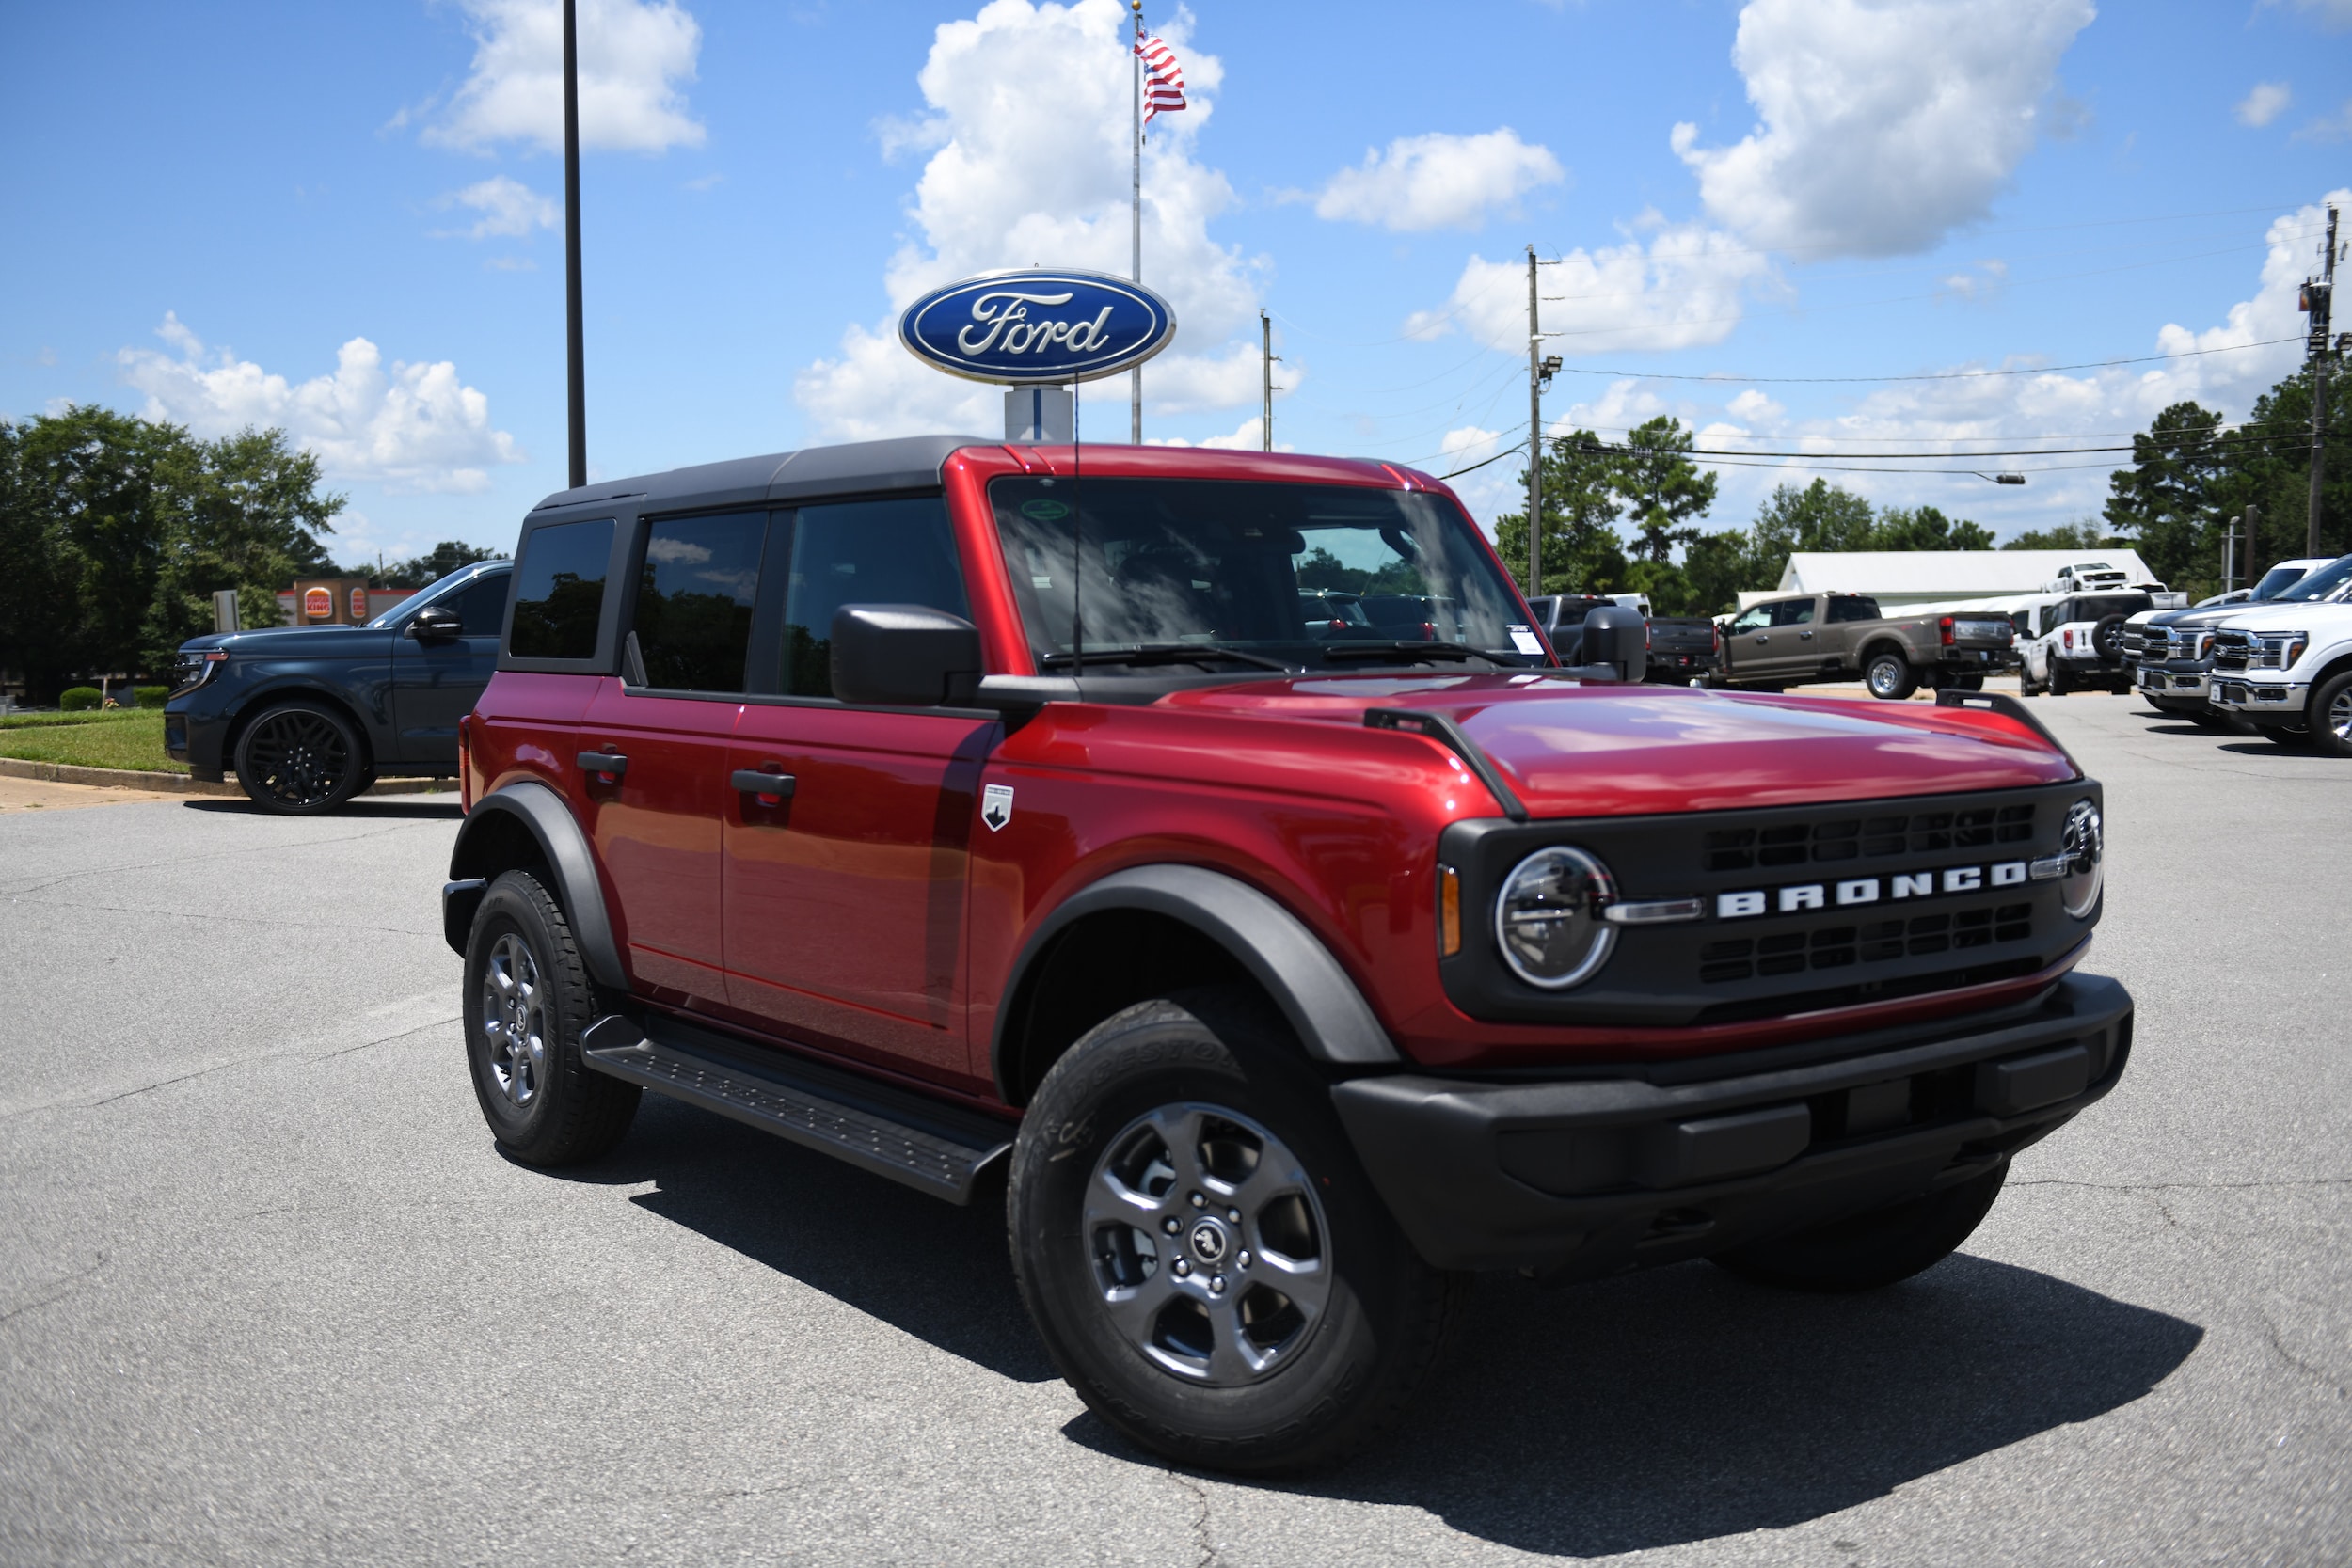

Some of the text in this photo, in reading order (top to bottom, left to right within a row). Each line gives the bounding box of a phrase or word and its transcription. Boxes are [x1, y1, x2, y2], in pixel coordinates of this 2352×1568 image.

[958, 293, 1115, 356] Ford
[307, 602, 330, 610] KING
[1716, 862, 2026, 918] BRONCO
[1025, 1041, 1242, 1175] BRIDGESTO
